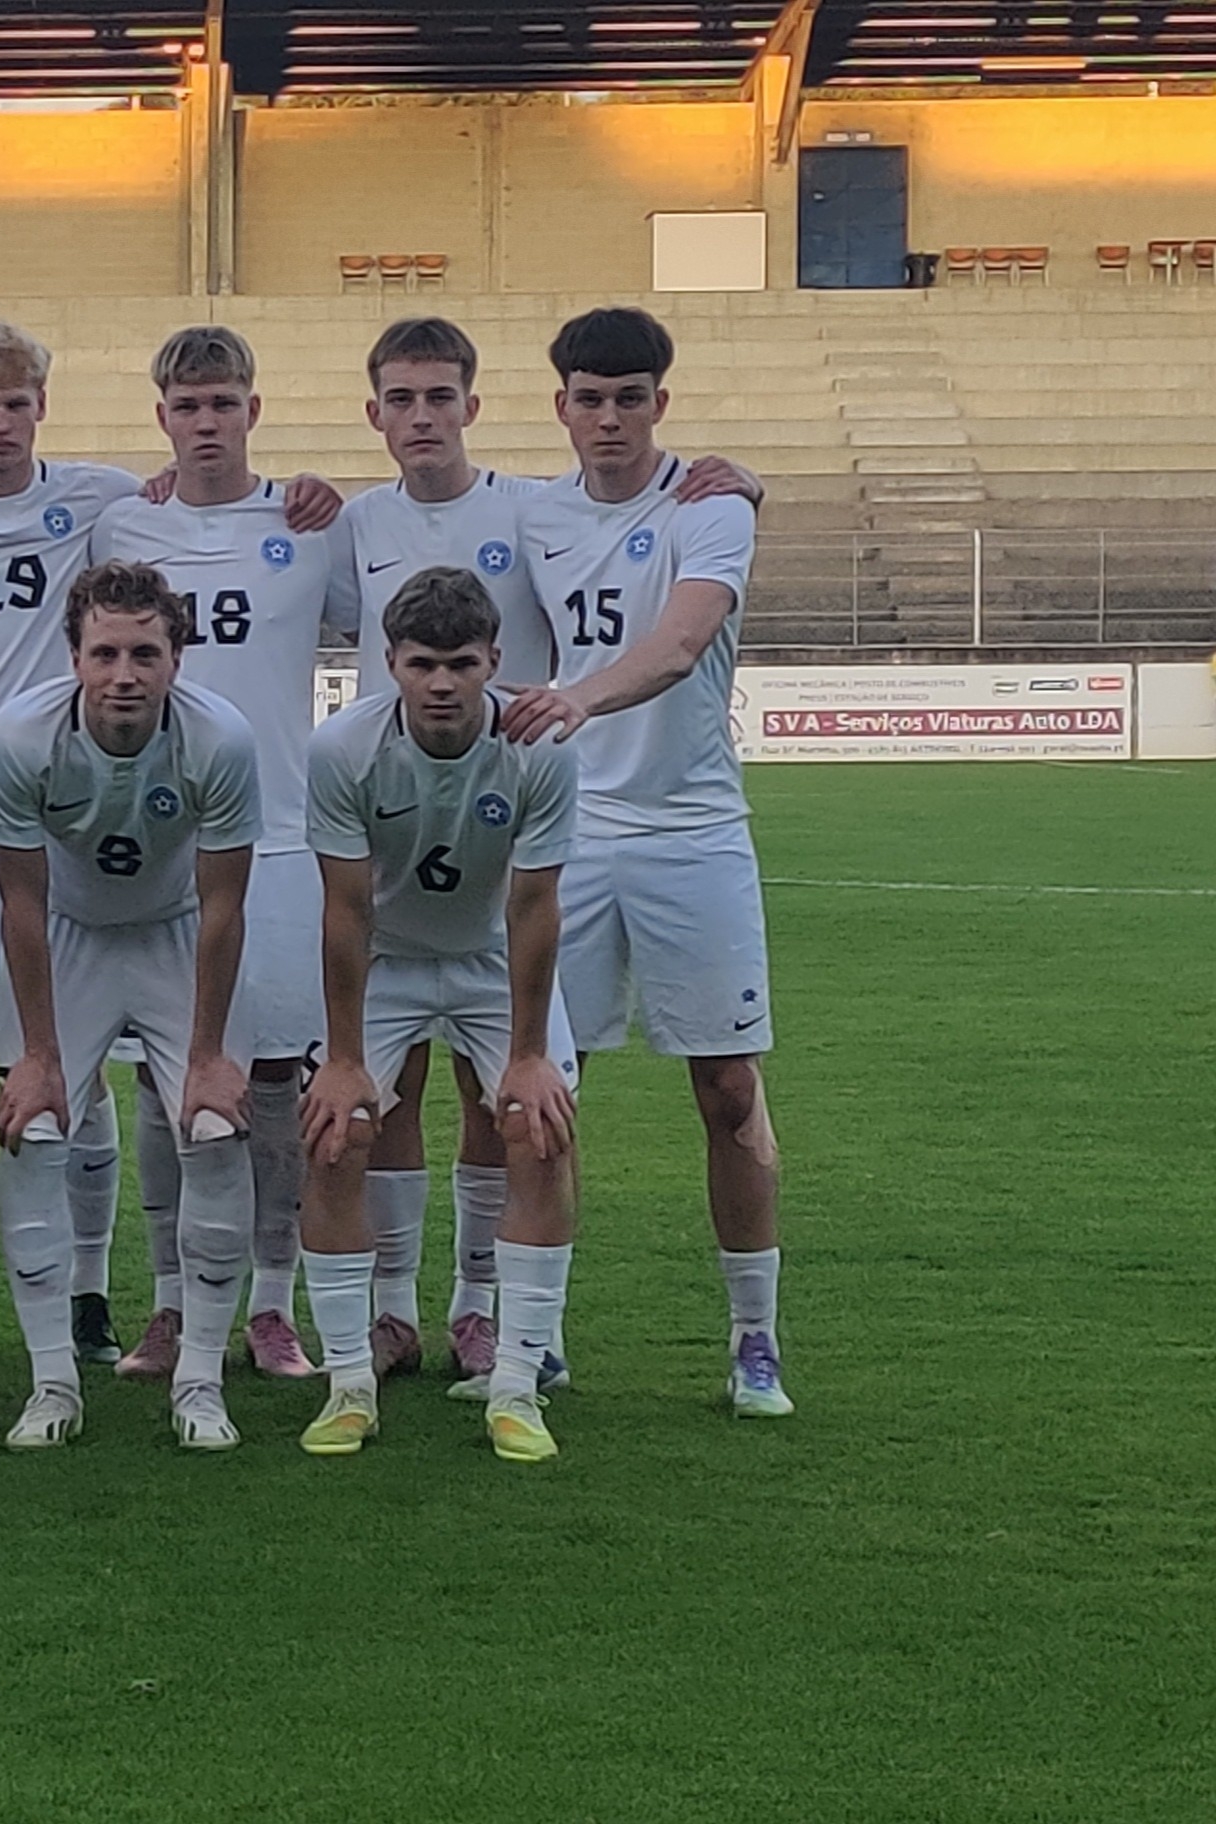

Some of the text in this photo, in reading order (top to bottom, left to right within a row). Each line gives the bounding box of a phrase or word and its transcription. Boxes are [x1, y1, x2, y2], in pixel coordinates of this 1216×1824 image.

[183, 589, 252, 645] 18
[564, 588, 625, 647] 15
[834, 712, 923, 736] Serviços
[927, 711, 1014, 732] Viaturas
[1018, 711, 1071, 731] Auto
[1075, 711, 1120, 730] LDA
[96, 834, 143, 877] 8
[415, 844, 462, 893] 6
